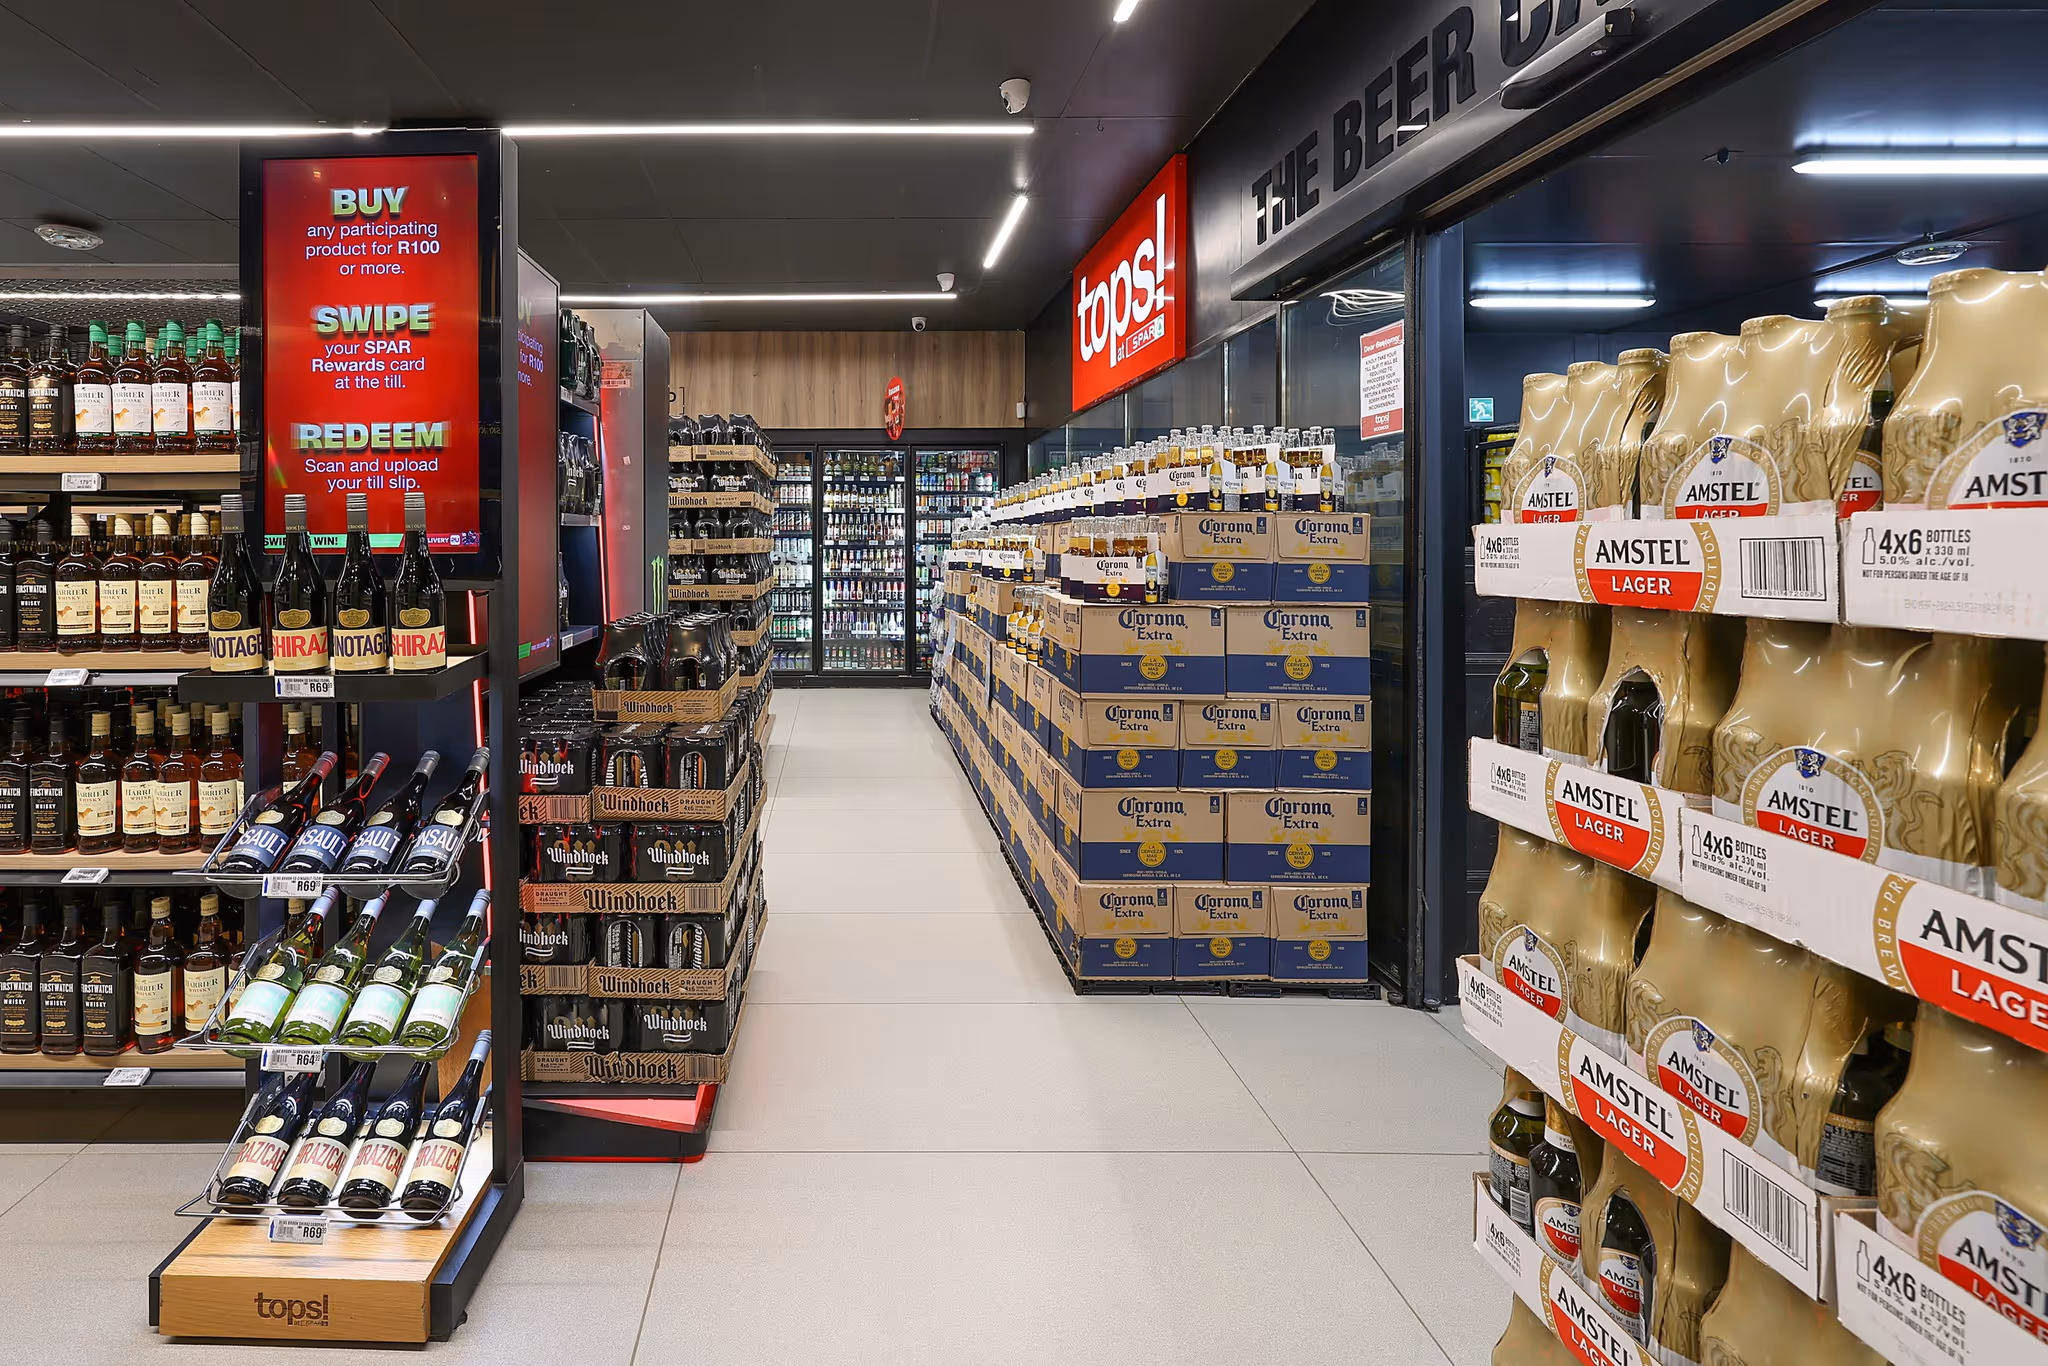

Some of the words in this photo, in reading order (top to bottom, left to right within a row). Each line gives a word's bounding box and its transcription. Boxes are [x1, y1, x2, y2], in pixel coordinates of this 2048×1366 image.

[1252, 130, 1320, 246] THE
[1333, 5, 1477, 192] BEER
[332, 187, 408, 217] BUY
[307, 225, 335, 239] any
[340, 222, 438, 238] participating
[305, 240, 366, 259] product
[371, 241, 393, 255] for
[397, 242, 440, 254] R100
[340, 263, 356, 275] or
[361, 263, 405, 275] more.
[1078, 193, 1166, 368] tops!
[313, 305, 434, 334] SWIPE
[325, 342, 360, 358] your
[364, 340, 411, 354] SPAR
[1116, 343, 1125, 361] at
[1132, 321, 1155, 349] SPAR
[311, 358, 385, 372] Rewards
[390, 358, 425, 372] card
[529, 354, 543, 373] R100
[335, 377, 351, 389] at
[355, 376, 380, 389] the
[384, 375, 406, 389] till.
[296, 422, 447, 450] REDEEM
[305, 459, 345, 473] Scan
[350, 459, 380, 473] and
[385, 458, 439, 476] upload
[327, 476, 362, 493] your
[367, 475, 385, 489] till
[389, 475, 420, 492] slip.
[1169, 470, 1195, 482] Corona
[1176, 480, 1191, 488] Extra
[1685, 482, 1759, 502] AMSTEL
[1964, 471, 2048, 499] AMST
[669, 496, 707, 505] Windhoek
[1527, 492, 1573, 508] AMSTEL
[1199, 517, 1254, 536] Corona
[1295, 518, 1350, 535] Corona
[314, 537, 338, 545] WIN!
[1213, 533, 1242, 545] Extra
[1309, 533, 1339, 545] Extra
[1486, 537, 1502, 554] 4x6
[1879, 529, 1922, 555] 4x6
[1927, 529, 1971, 543] BOTTLES
[1595, 539, 1690, 566] AMSTEL
[1935, 546, 1953, 556] 330
[1957, 547, 1969, 556] ml
[1097, 560, 1128, 571] Corona
[1880, 556, 1909, 565] 5.0%
[1105, 569, 1123, 577] Extra
[16, 585, 47, 594] FIRSTWATCH
[1612, 576, 1672, 595] LAGER
[1118, 608, 1187, 630] Corona
[1263, 608, 1332, 631] Corona
[1137, 630, 1173, 642] Extra
[1282, 630, 1318, 642] Extra
[310, 683, 328, 692] R69
[624, 700, 674, 714] Windhoek
[1105, 704, 1160, 722] Corona
[1202, 704, 1258, 721] Corona
[1297, 706, 1352, 723] Corona
[1119, 721, 1149, 732] Extra
[1217, 720, 1246, 732] Extra
[1311, 722, 1340, 733] Extra
[1497, 766, 1511, 782] 4x6
[1751, 753, 1790, 792] PREMIUM
[30, 788, 63, 797] FIRSTWATCH
[1562, 779, 1639, 823] AMSTEL
[600, 793, 669, 814] Windhoek
[1117, 797, 1186, 817] Corona
[1265, 797, 1333, 818] Corona
[1767, 789, 1859, 832] AMSTEL
[1135, 816, 1172, 829] Extra
[1283, 816, 1319, 830] Extra
[1575, 812, 1625, 843] LAGER
[1642, 798, 1661, 872] TRADITION
[1778, 819, 1836, 850] LAGER
[1703, 831, 1733, 858] 4x6
[1736, 840, 1767, 860] BOTTLES
[547, 847, 609, 865] Windhoek
[647, 847, 710, 866] Windhoek
[1704, 852, 1725, 865] 5.0%
[1742, 856, 1754, 867] 330
[1757, 862, 1766, 870] ml
[297, 881, 315, 891] R69
[583, 889, 678, 912] Windhoek
[1099, 892, 1155, 909] Corona
[1194, 893, 1250, 910] Corona
[1294, 894, 1349, 910] Corona
[1115, 908, 1144, 919] Extra
[1209, 909, 1239, 920] Extra
[1309, 909, 1338, 921] Extra
[1508, 954, 1556, 994] AMSTEL
[40, 983, 73, 992] FIRSTWATCH
[599, 975, 670, 995] Windhoek
[1470, 976, 1485, 999] 4x6
[1515, 977, 1544, 1008] LAGER
[547, 1024, 610, 1040] Windhoek
[643, 1015, 707, 1032] Windhoek
[1652, 1021, 1687, 1048] PREMIUM
[297, 1055, 314, 1065] R64
[1667, 1050, 1740, 1110] AMSTEL
[1579, 1055, 1674, 1140] AMSTEL
[1678, 1081, 1723, 1125] LAGER
[1595, 1099, 1656, 1158] LAGER
[303, 1227, 321, 1238] R69
[1873, 1255, 1916, 1302] 4x6
[1920, 1283, 1966, 1325] BOTTLES
[254, 1292, 328, 1325] tops!
